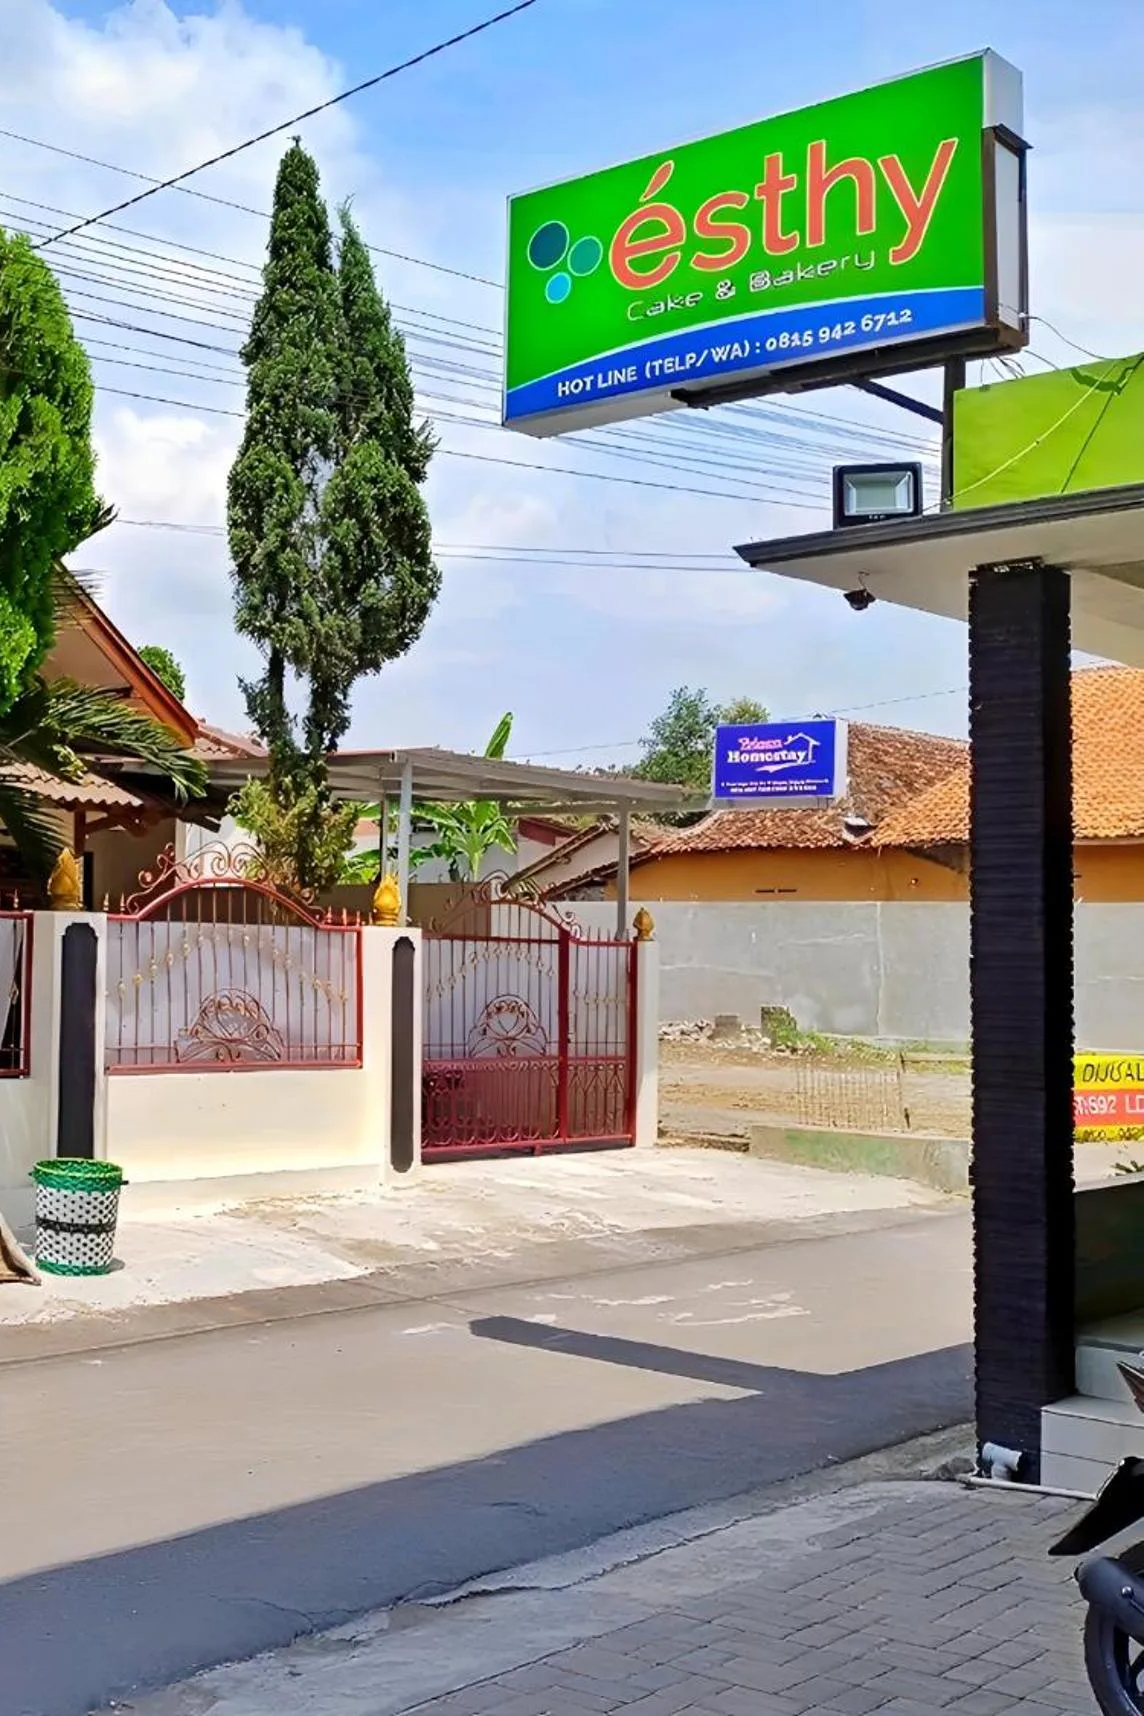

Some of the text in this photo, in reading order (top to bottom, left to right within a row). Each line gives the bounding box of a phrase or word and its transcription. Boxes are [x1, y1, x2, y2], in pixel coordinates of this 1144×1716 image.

[608, 137, 959, 290] ésthy
[627, 250, 875, 321] Cake & Bakery
[765, 328, 812, 351] 0815
[818, 321, 856, 341] 942
[860, 309, 912, 332] 6712
[727, 749, 806, 765] Homestay
